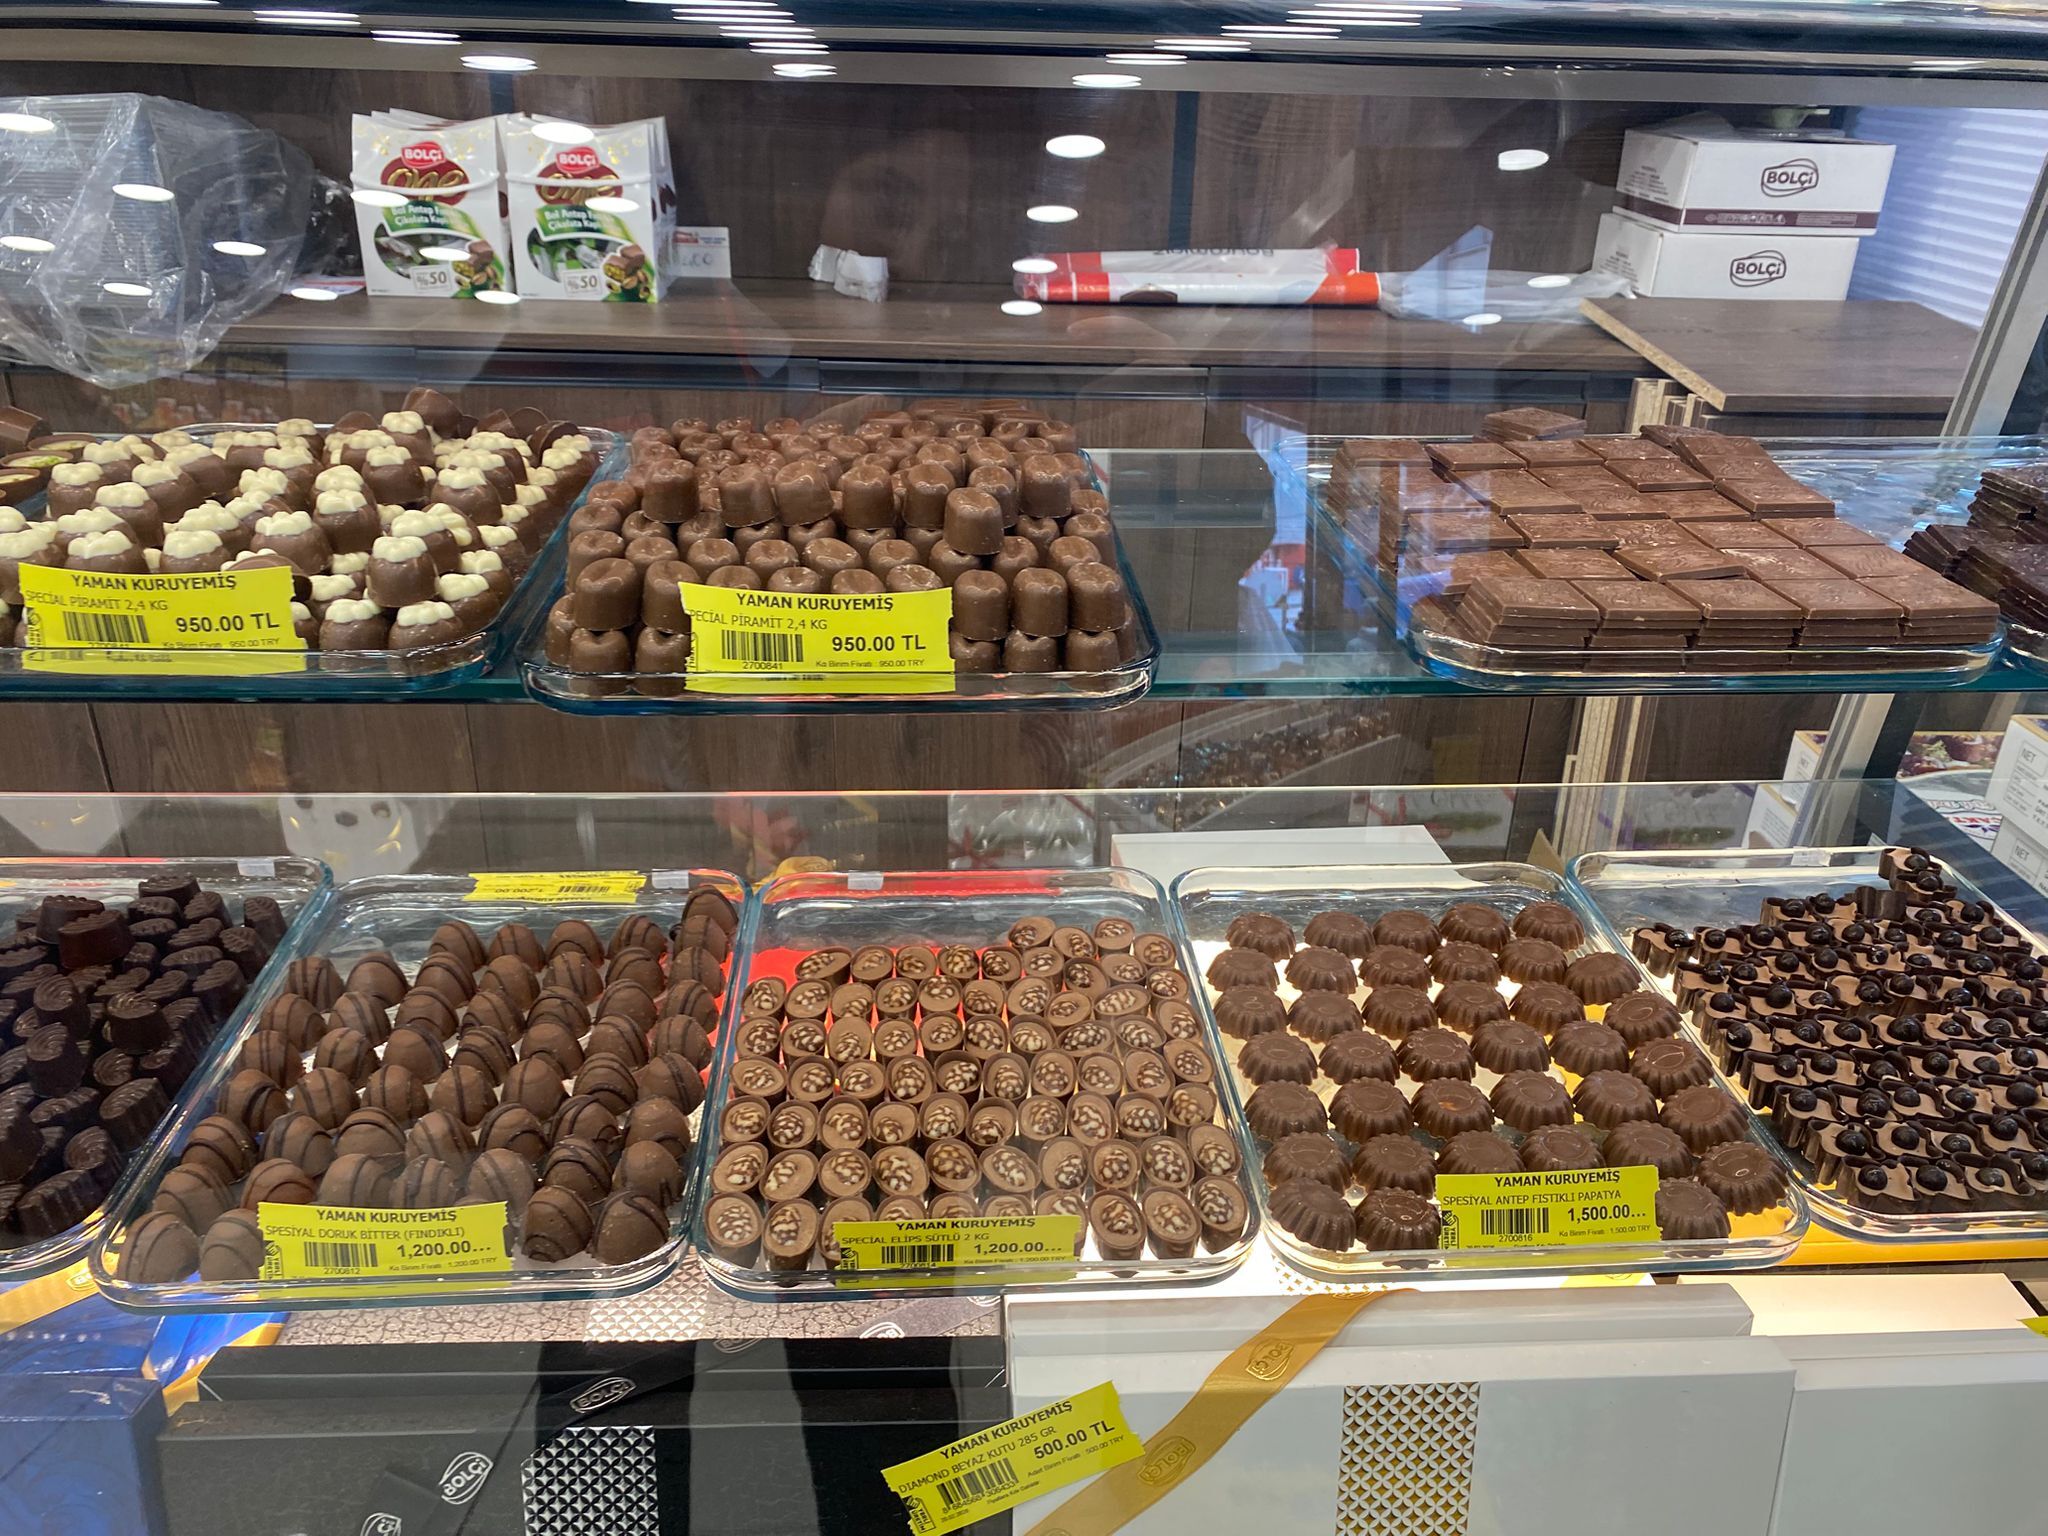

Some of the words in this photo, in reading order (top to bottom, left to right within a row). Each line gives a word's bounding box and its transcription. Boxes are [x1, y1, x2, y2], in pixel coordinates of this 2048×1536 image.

[71, 574, 127, 590] YAMAN
[132, 573, 236, 591] KURUYEMİŞ
[70, 594, 120, 609] PİRAMİT
[126, 600, 145, 612] 2,4
[149, 600, 168, 610] KG
[736, 592, 792, 609] YAMAN
[797, 594, 894, 611] KURUYEMİŞ
[175, 614, 244, 632] 950.00
[250, 612, 279, 629] TL
[689, 609, 727, 624] PECİAL
[731, 614, 783, 629] PİRAMİT
[787, 618, 806, 631] 2,4
[811, 619, 828, 630] KG
[832, 636, 895, 651] 950.00
[901, 635, 926, 650] TL
[743, 661, 783, 670] 2700841
[1494, 1175, 1541, 1187] YAMAN
[1545, 1168, 1621, 1185] KURUYEMİŞ
[1443, 1194, 1492, 1206] SPESİYAL
[1495, 1194, 1530, 1205] ANTEP
[1532, 1192, 1575, 1204] FISTIKLI
[1578, 1190, 1622, 1201] PAPATYA
[316, 1209, 366, 1221] YAMAN
[370, 1208, 457, 1223] KURUYEMİŞ
[896, 1221, 947, 1231] YAMAN
[951, 1217, 1036, 1229] KURUYEMİŞ
[265, 1225, 315, 1237] SPESİYAL
[319, 1228, 358, 1239] DORUK
[360, 1228, 401, 1240] BİTTER
[404, 1227, 465, 1241] (FINDIKLI)
[841, 1235, 887, 1245] SPECİAL
[891, 1235, 922, 1244] ELİPS
[925, 1233, 961, 1242] SÜTLÜ
[964, 1233, 971, 1241] 2
[1498, 1234, 1533, 1243] 2700816
[940, 1434, 990, 1460] YAMAN
[992, 1400, 1073, 1439] KURUYEMİŞ
[1033, 1429, 1088, 1459] 500.00
[1089, 1420, 1116, 1436] TL
[898, 1468, 950, 1493] DIAMOND
[951, 1454, 987, 1474] BEYAZ
[987, 1442, 1016, 1459] KUTU
[1018, 1432, 1038, 1447] 285
[1040, 1426, 1057, 1438] GR
